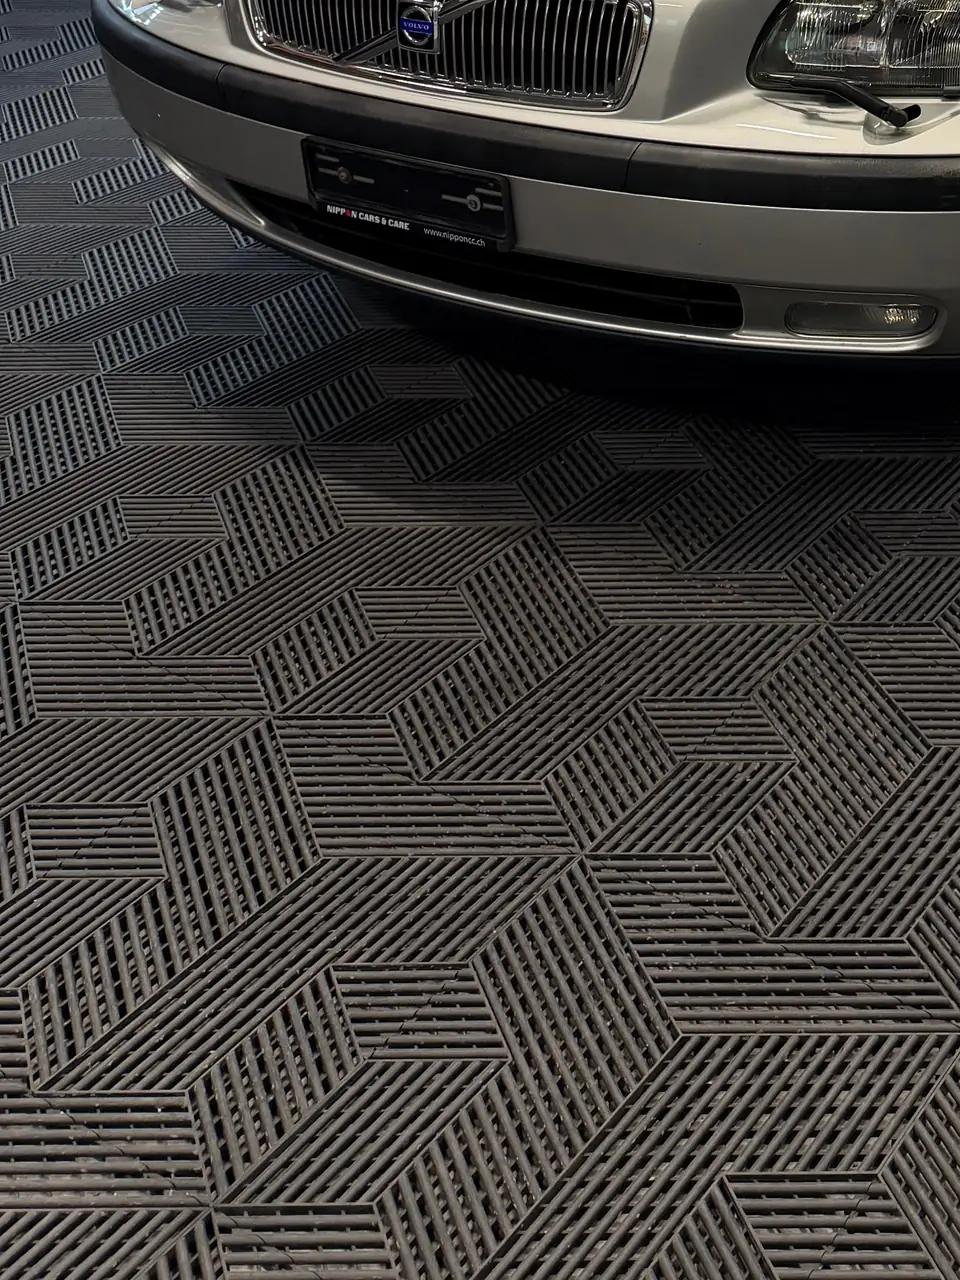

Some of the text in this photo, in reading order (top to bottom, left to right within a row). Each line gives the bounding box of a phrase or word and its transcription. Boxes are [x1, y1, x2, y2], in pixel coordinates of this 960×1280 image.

[403, 21, 430, 30] VOLVO
[326, 204, 411, 231] NIPPON CARS & CARE
[423, 227, 486, 248] www.nipponcc.ch
